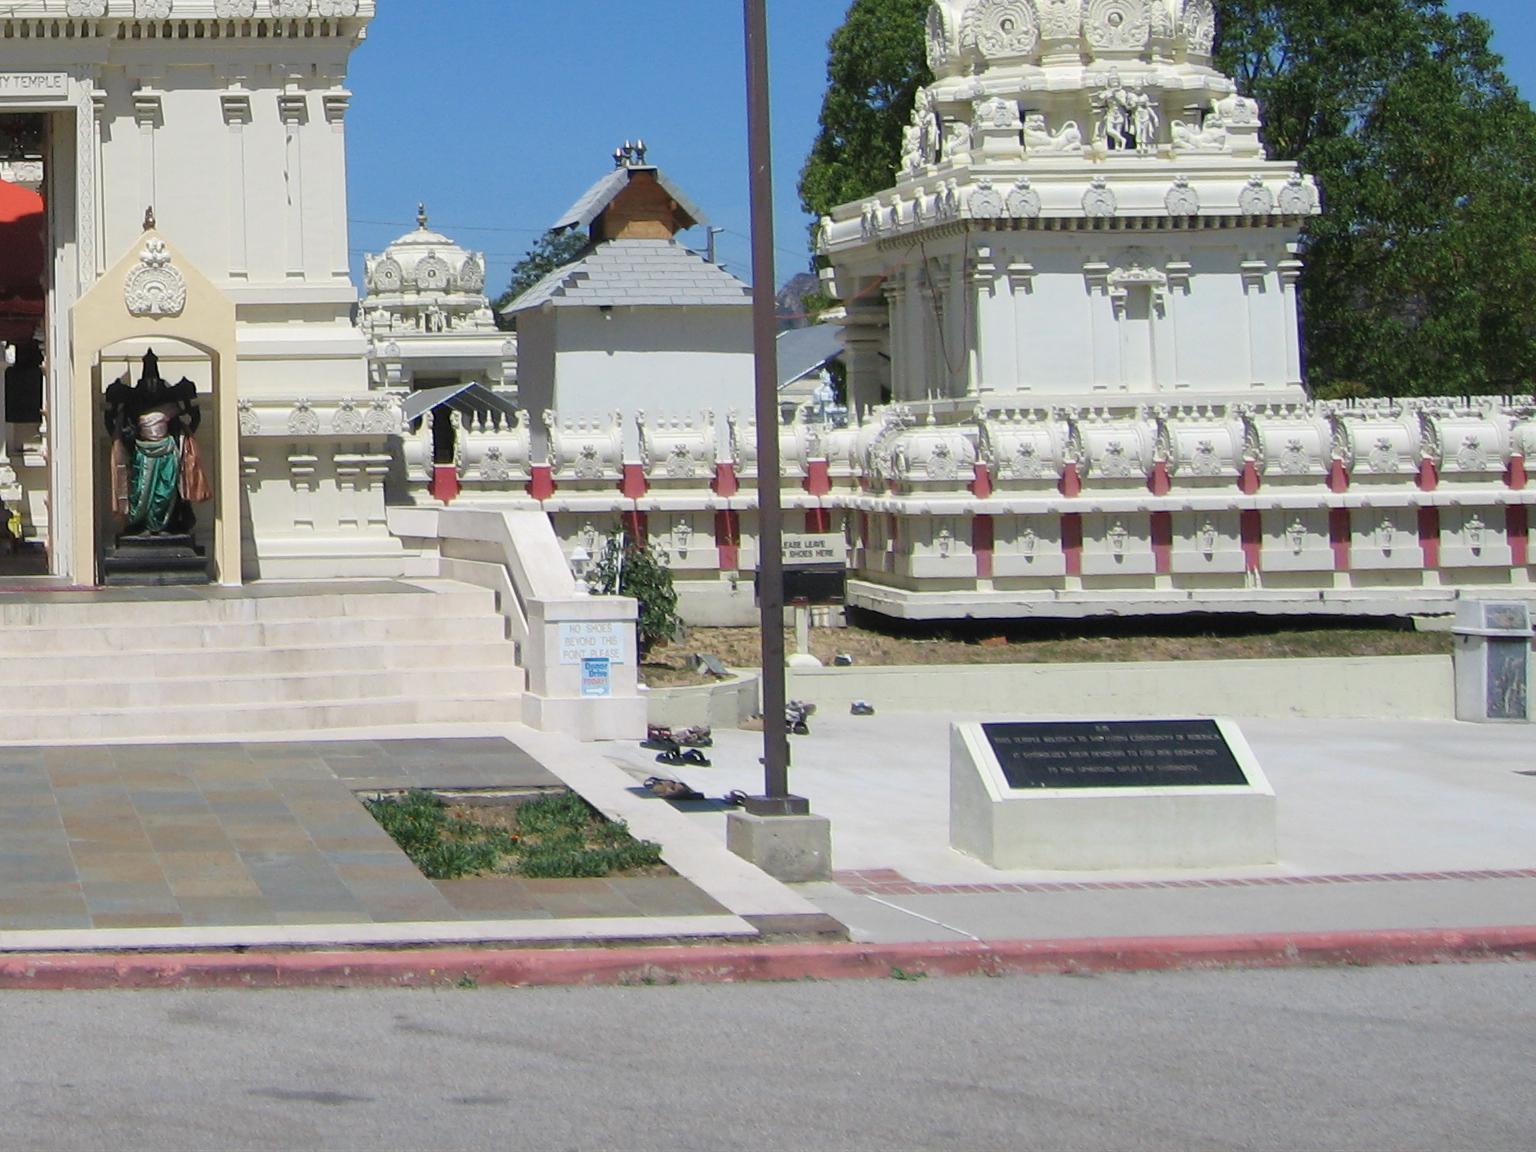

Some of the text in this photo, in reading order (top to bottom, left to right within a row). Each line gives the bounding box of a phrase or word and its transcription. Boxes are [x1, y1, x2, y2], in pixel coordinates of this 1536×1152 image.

[13, 76, 62, 88] TEMPLE
[804, 540, 825, 548] LEAVE
[816, 549, 833, 557] HERE
[569, 623, 613, 633] NO SHOES
[564, 635, 618, 646] BEYOND THIS
[562, 648, 620, 659] POINT PLEASE
